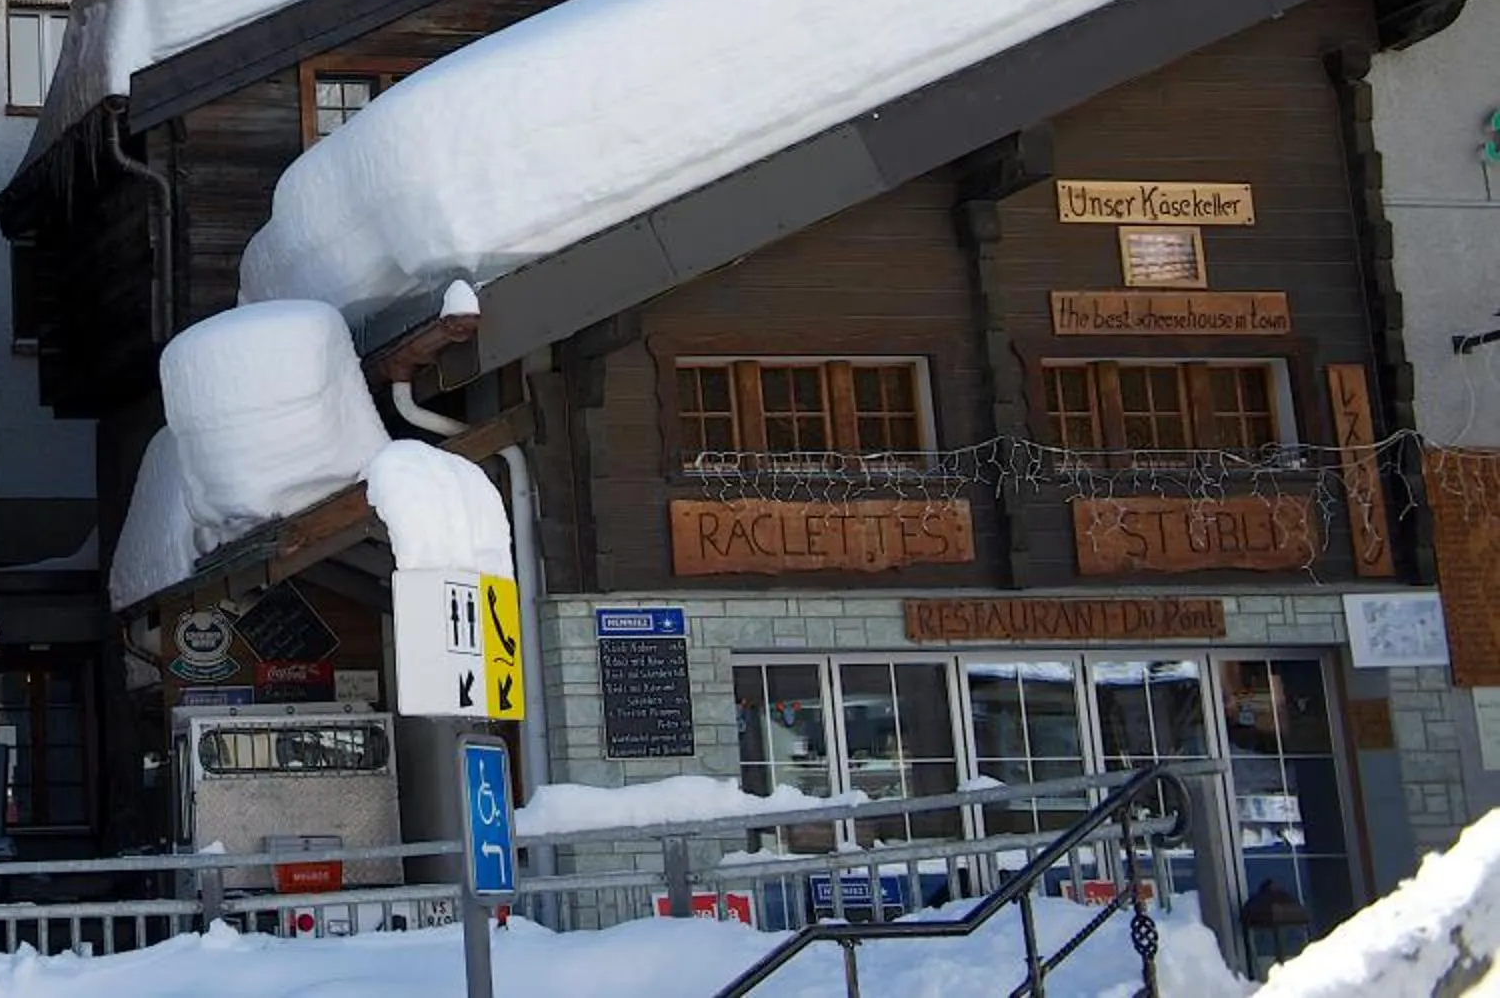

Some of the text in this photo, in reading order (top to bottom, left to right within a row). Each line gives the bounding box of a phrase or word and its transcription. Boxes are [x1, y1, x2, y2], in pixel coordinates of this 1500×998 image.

[1067, 185, 1136, 218] Unser
[1093, 298, 1131, 330] best
[699, 511, 949, 559] RACLETTES
